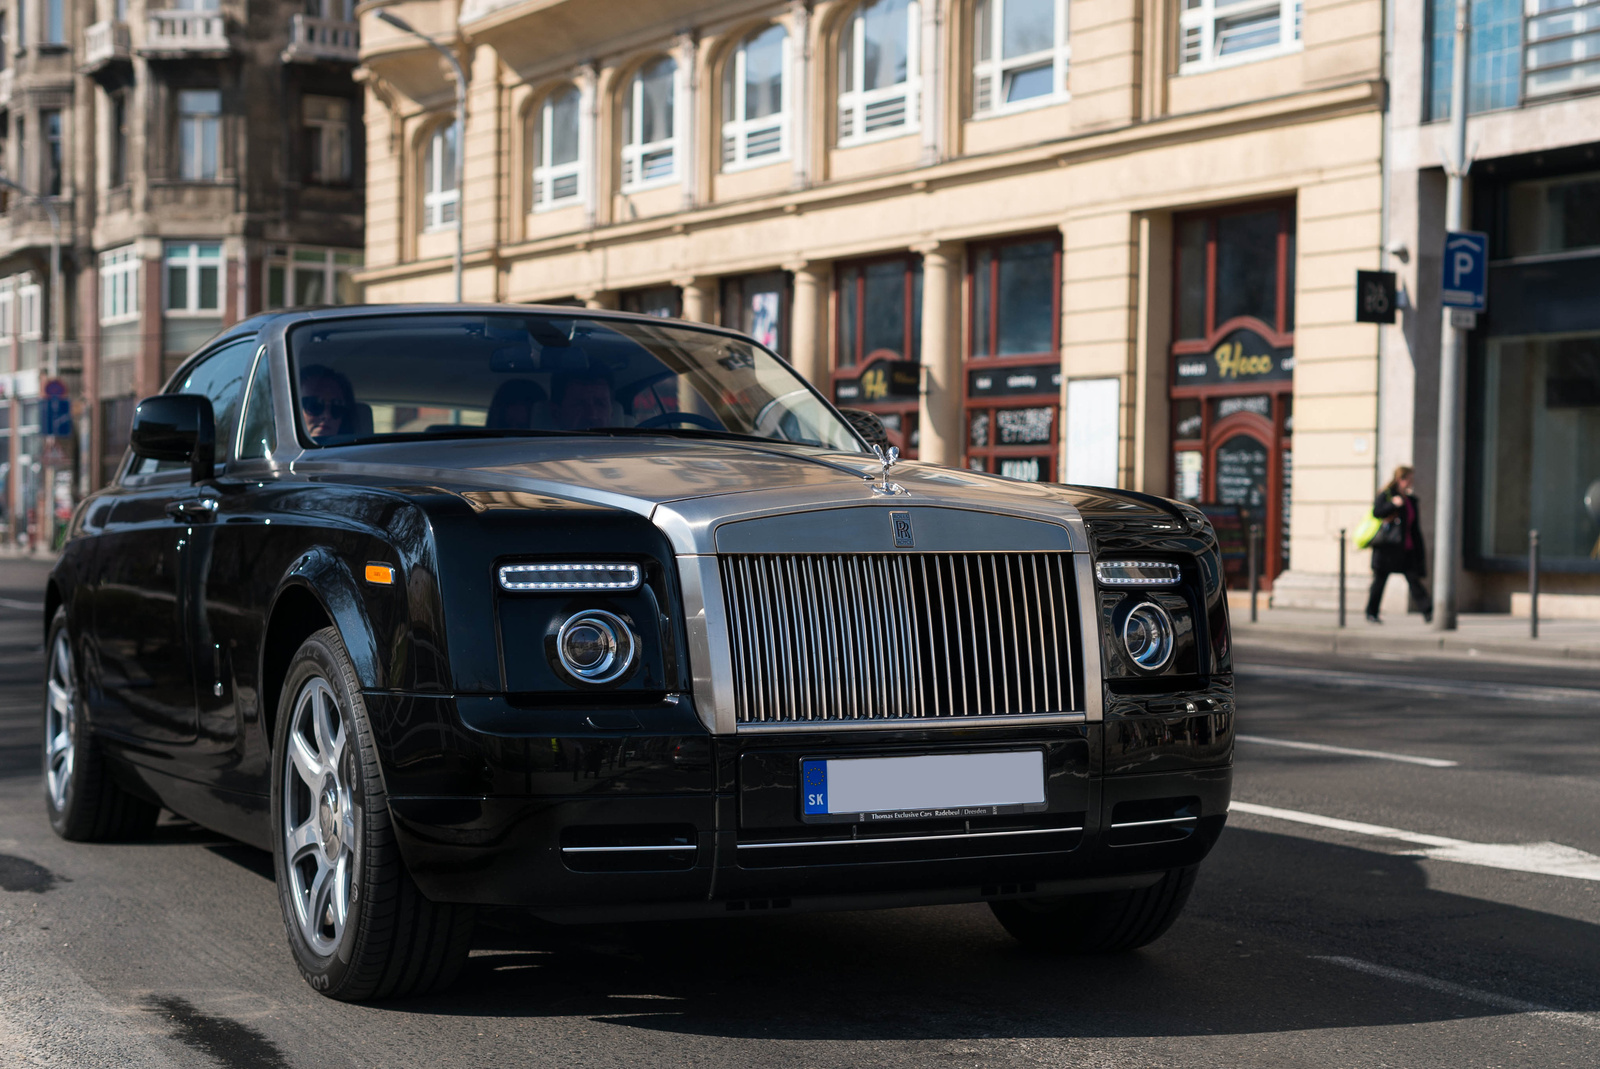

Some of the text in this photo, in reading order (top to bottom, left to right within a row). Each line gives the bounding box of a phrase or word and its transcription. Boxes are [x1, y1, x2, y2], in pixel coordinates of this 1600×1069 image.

[1454, 251, 1474, 288] P
[808, 793, 824, 806] SK
[894, 811, 919, 819] Exclusive
[919, 810, 932, 818] Cars
[934, 809, 960, 817] Radebeul
[964, 808, 987, 816] Dresden
